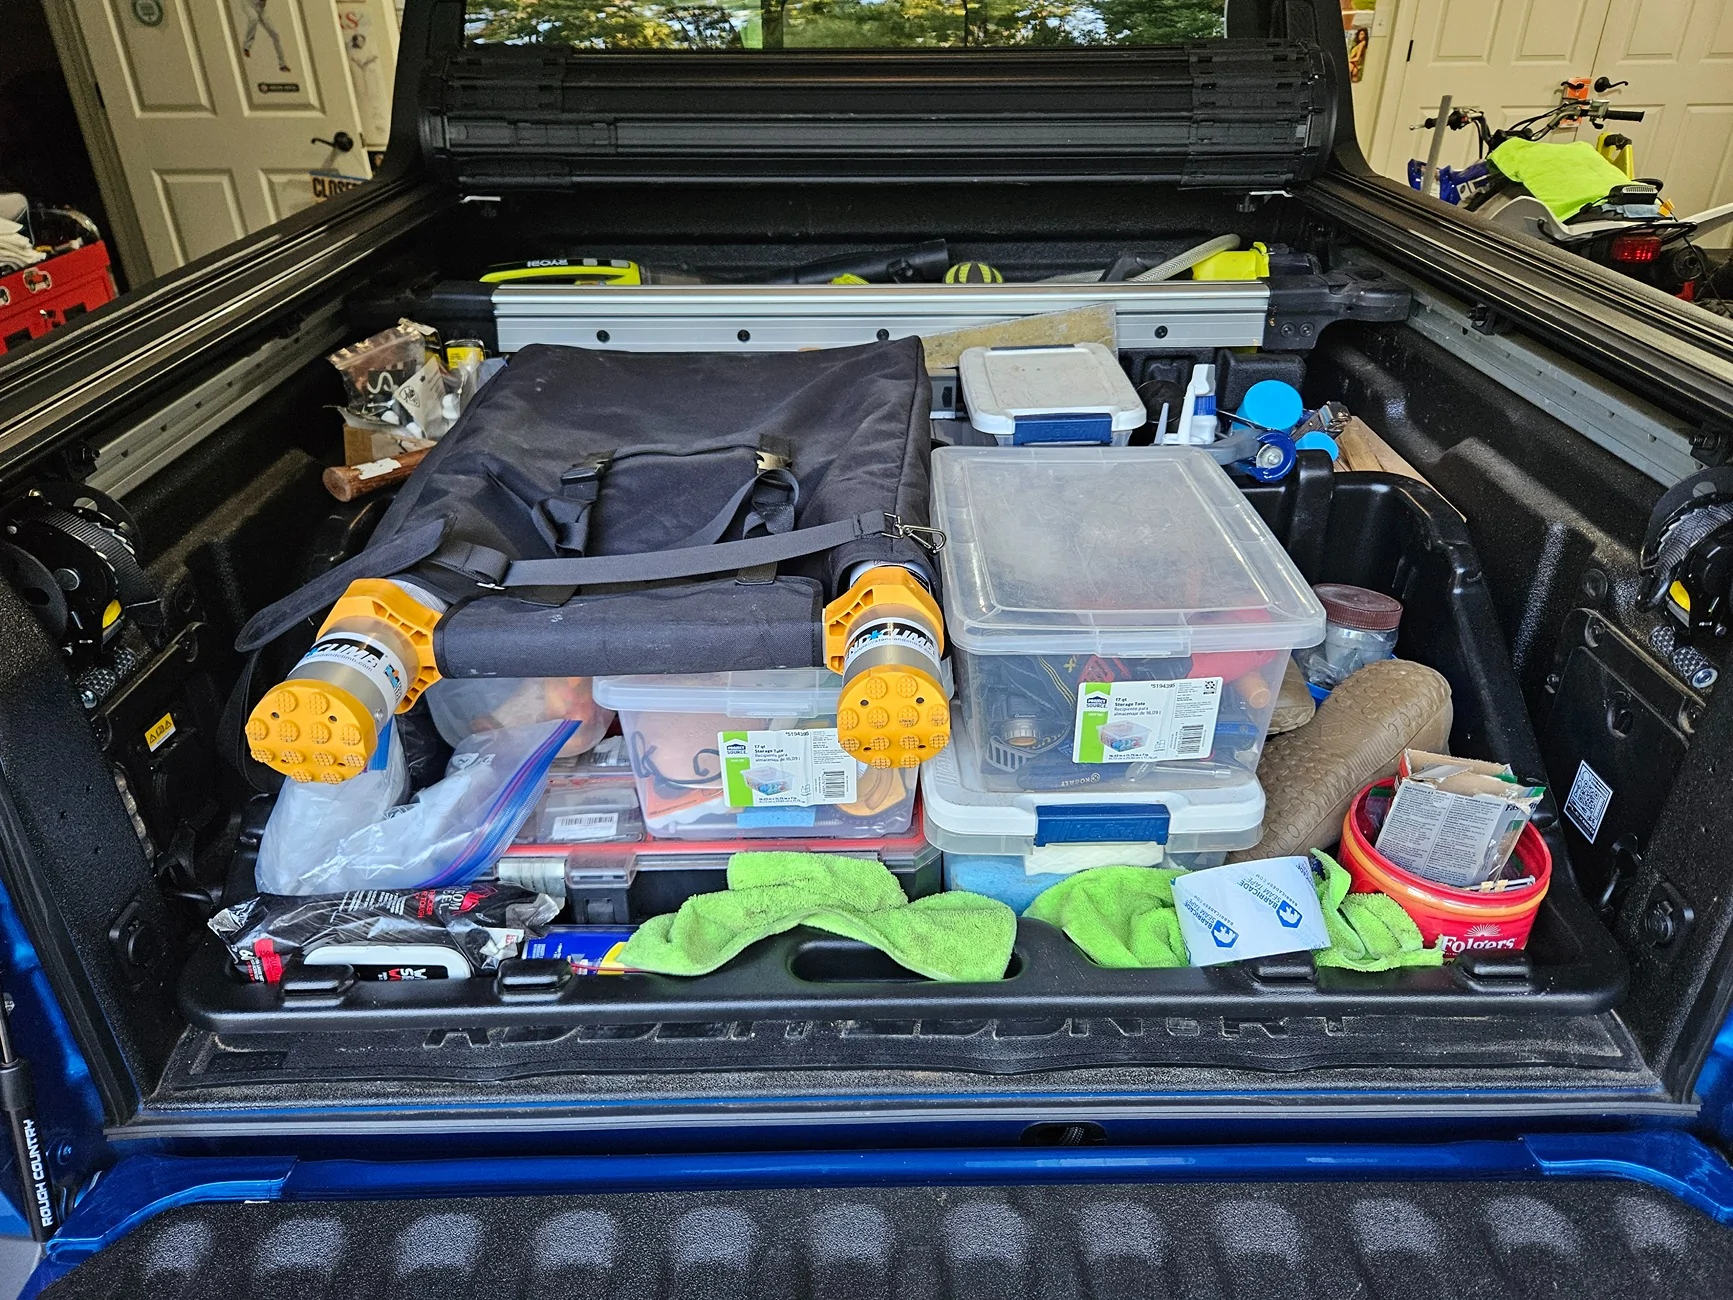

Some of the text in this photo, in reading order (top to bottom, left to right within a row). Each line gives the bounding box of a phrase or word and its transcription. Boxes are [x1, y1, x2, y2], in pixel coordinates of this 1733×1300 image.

[528, 259, 568, 268] RYOBI
[1238, 880, 1278, 910] BARRICADE
[1244, 877, 1282, 903] SEAM TAPE
[1184, 900, 1213, 930] BARRICADE
[1186, 898, 1217, 924] SEAM TAPE
[1442, 936, 1516, 952] Folgers
[23, 1119, 54, 1227] ROUGH COUNTRY
